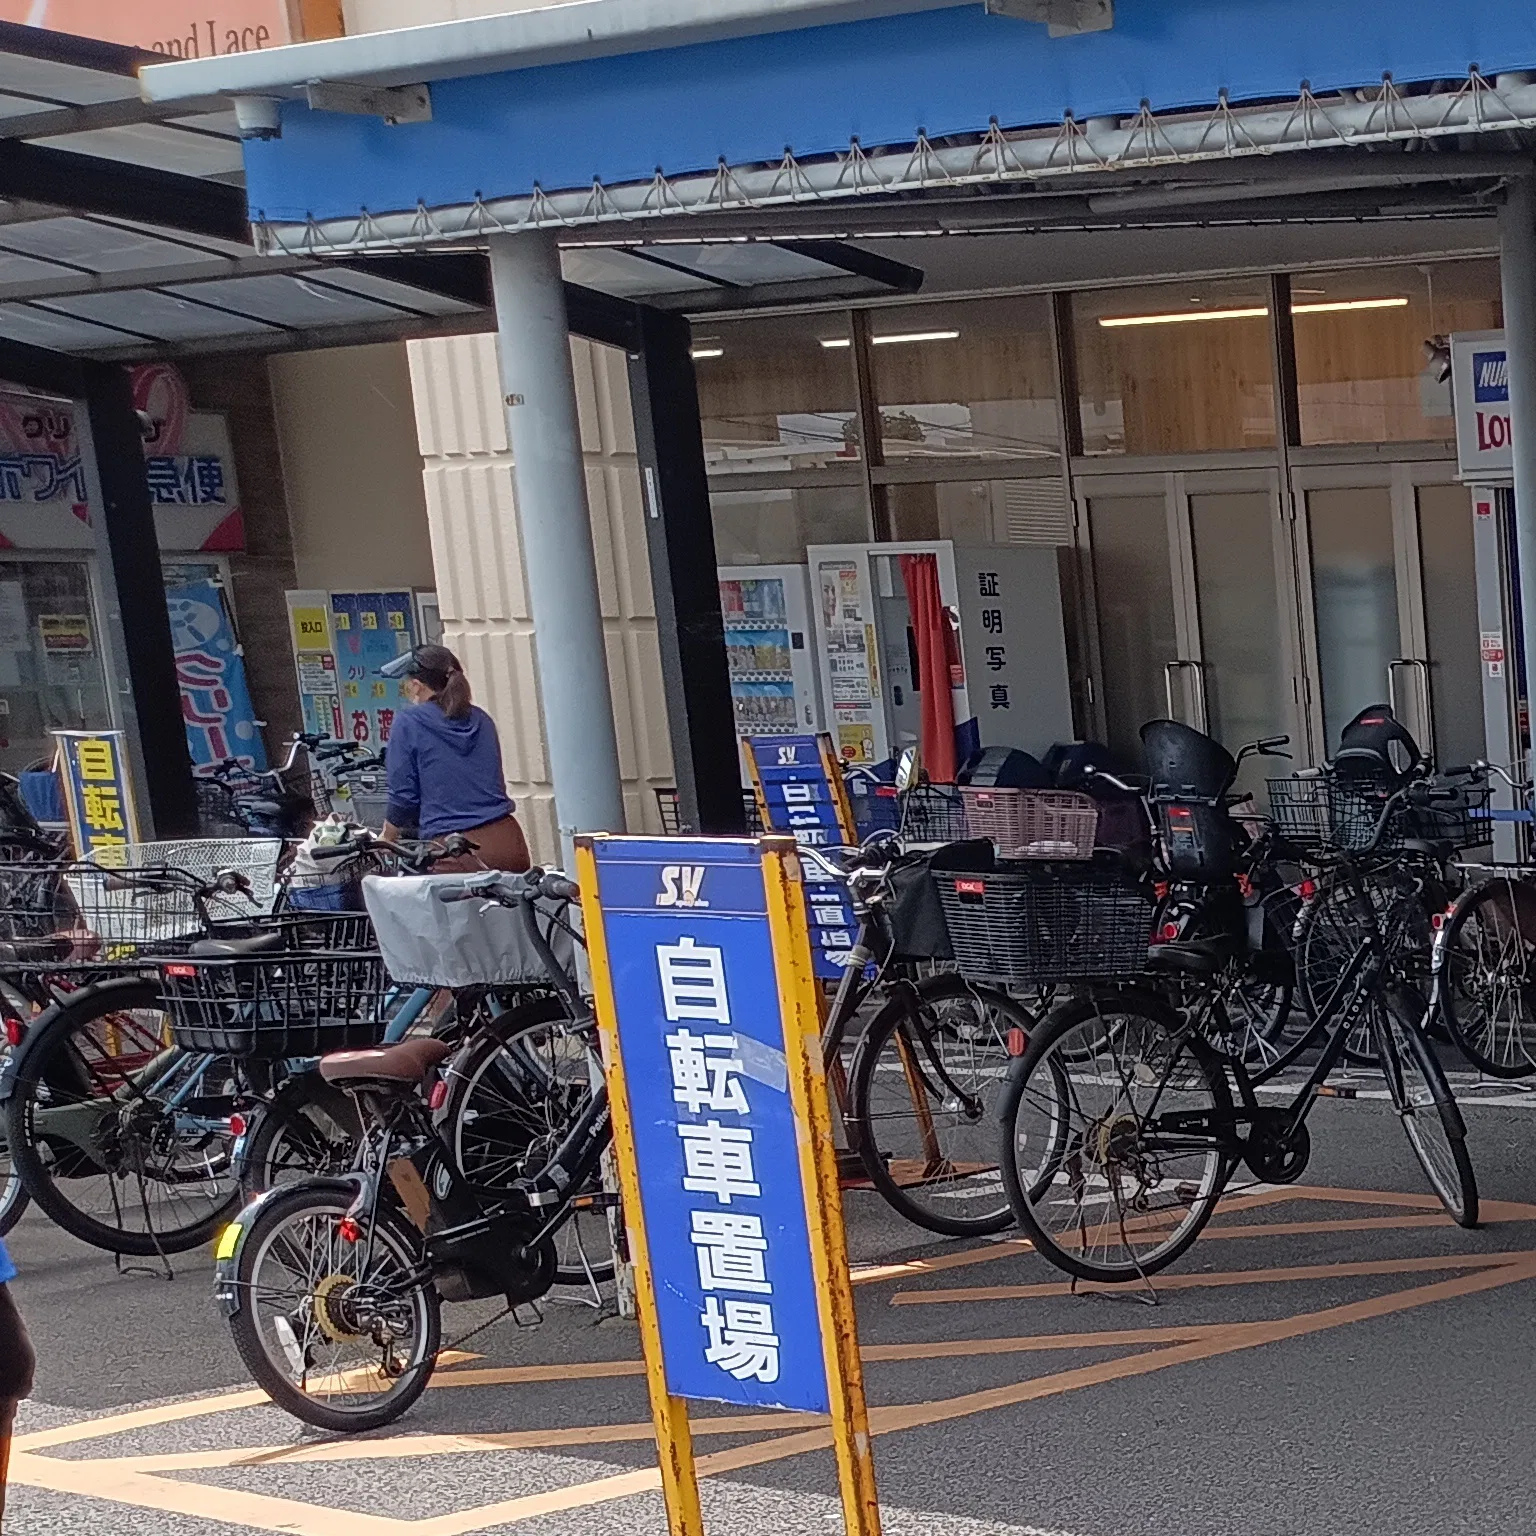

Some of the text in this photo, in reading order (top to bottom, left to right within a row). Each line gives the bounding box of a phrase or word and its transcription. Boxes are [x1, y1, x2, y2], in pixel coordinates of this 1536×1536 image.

[205, 20, 270, 56] Lace
[978, 572, 1010, 709] 証明写真
[656, 866, 706, 906] SV
[655, 936, 781, 1385] 自転車置場
